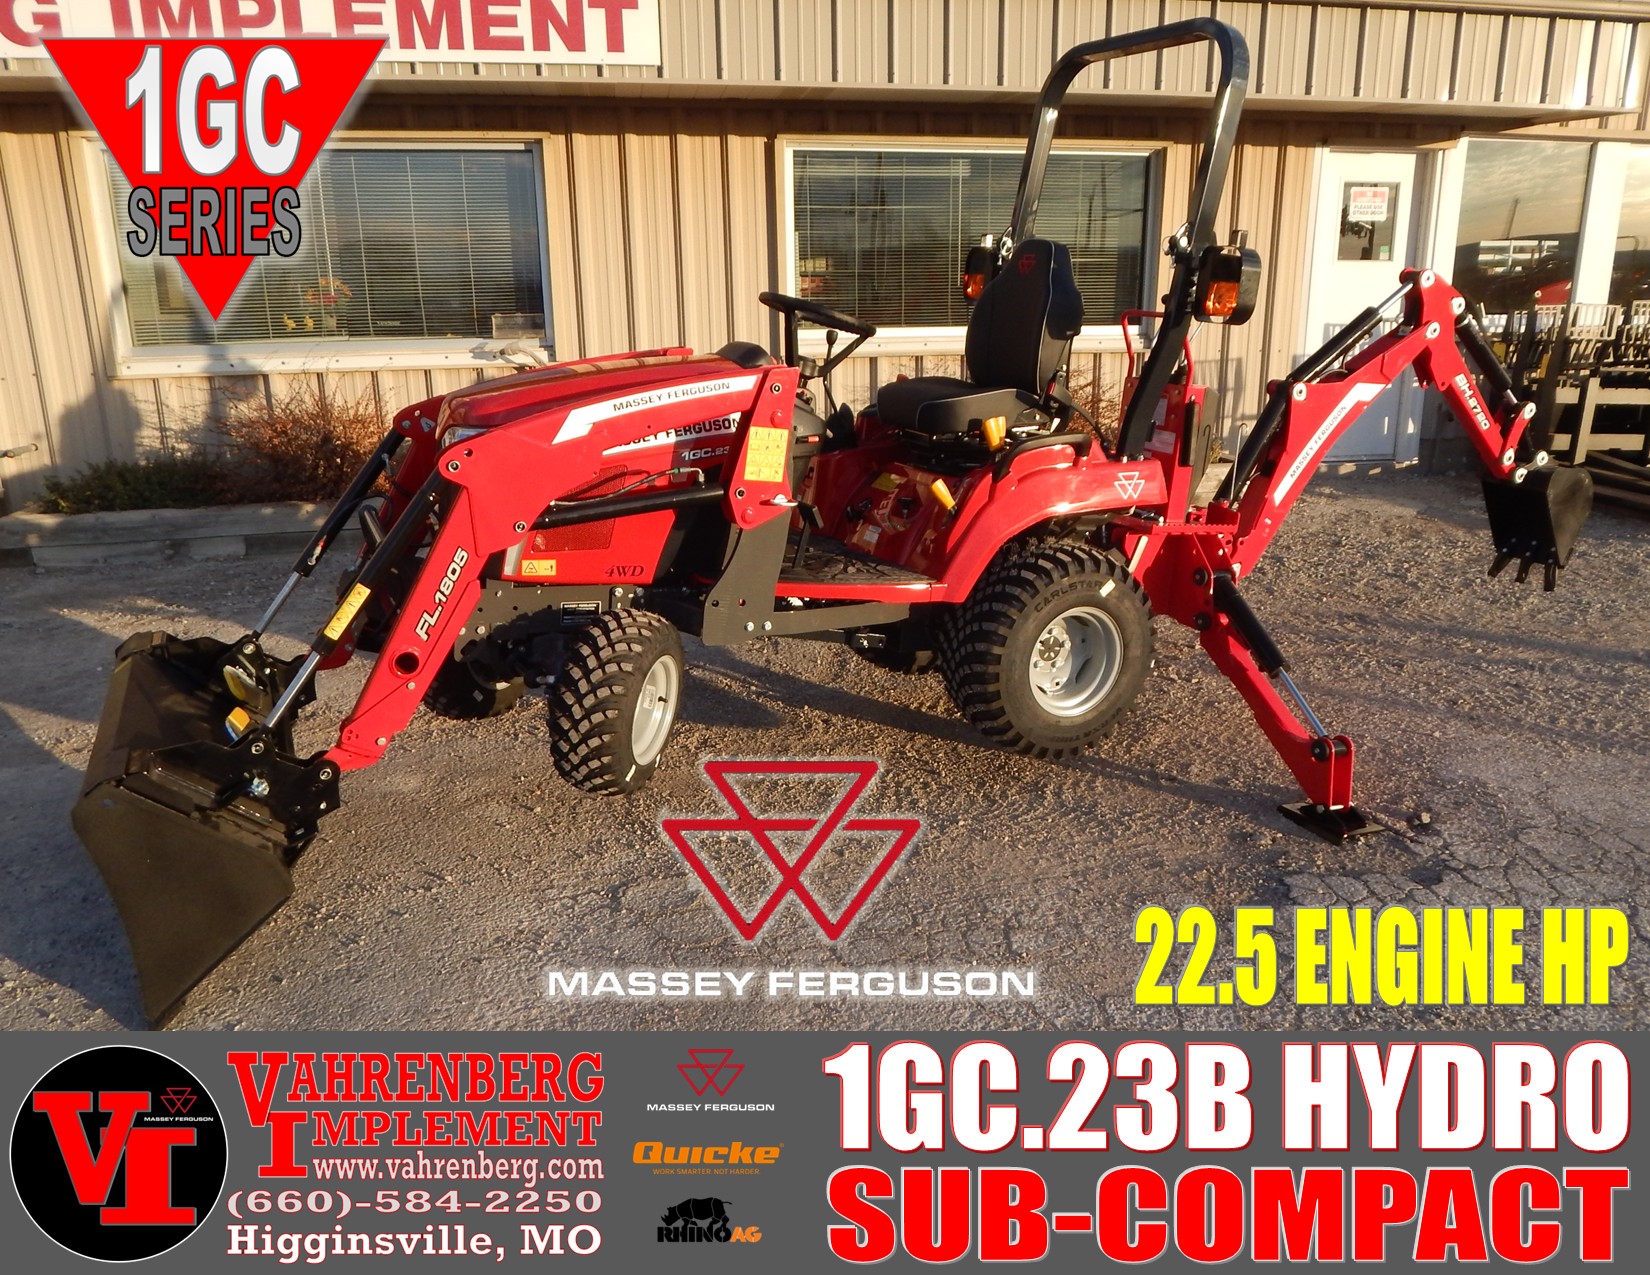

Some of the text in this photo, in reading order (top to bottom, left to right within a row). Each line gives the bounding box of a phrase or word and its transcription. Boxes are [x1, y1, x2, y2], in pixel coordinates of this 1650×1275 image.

[110, 0, 639, 53] IMPLEMENT
[613, 382, 731, 412] MASSEY FERGUSON
[666, 417, 740, 439] FERGUSON
[1290, 405, 1347, 479] MASSEY FERGUSON
[605, 564, 645, 578] 4WD
[414, 546, 469, 642] FL.1805
